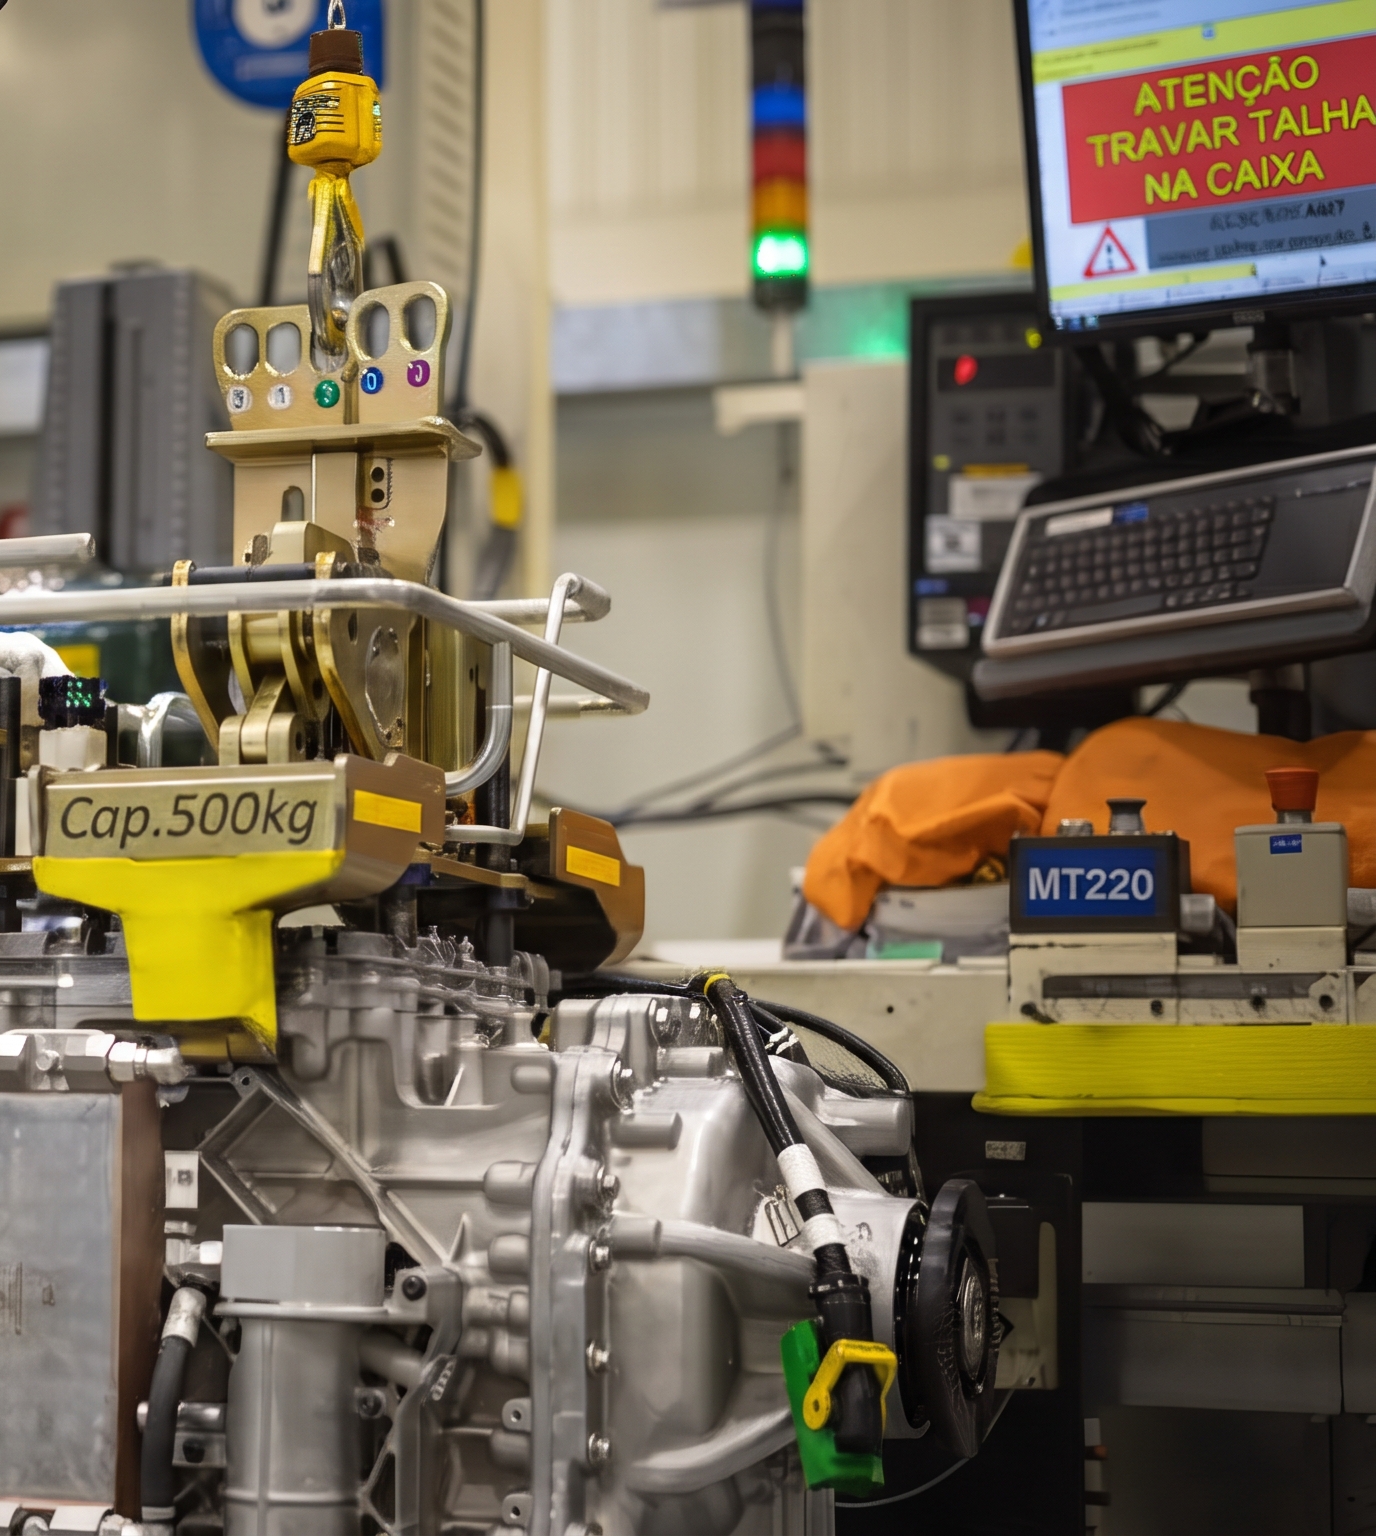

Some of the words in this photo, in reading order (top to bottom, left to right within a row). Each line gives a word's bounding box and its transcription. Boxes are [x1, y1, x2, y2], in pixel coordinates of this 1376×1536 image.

[1133, 55, 1320, 116] ATENÇÃO
[1086, 115, 1240, 167] TRAVAR
[1247, 94, 1376, 143] TALHA
[1144, 167, 1198, 205] NA
[1206, 149, 1325, 196] CAIXA
[60, 789, 318, 849] Cap.500kg
[1029, 867, 1154, 901] MT220
